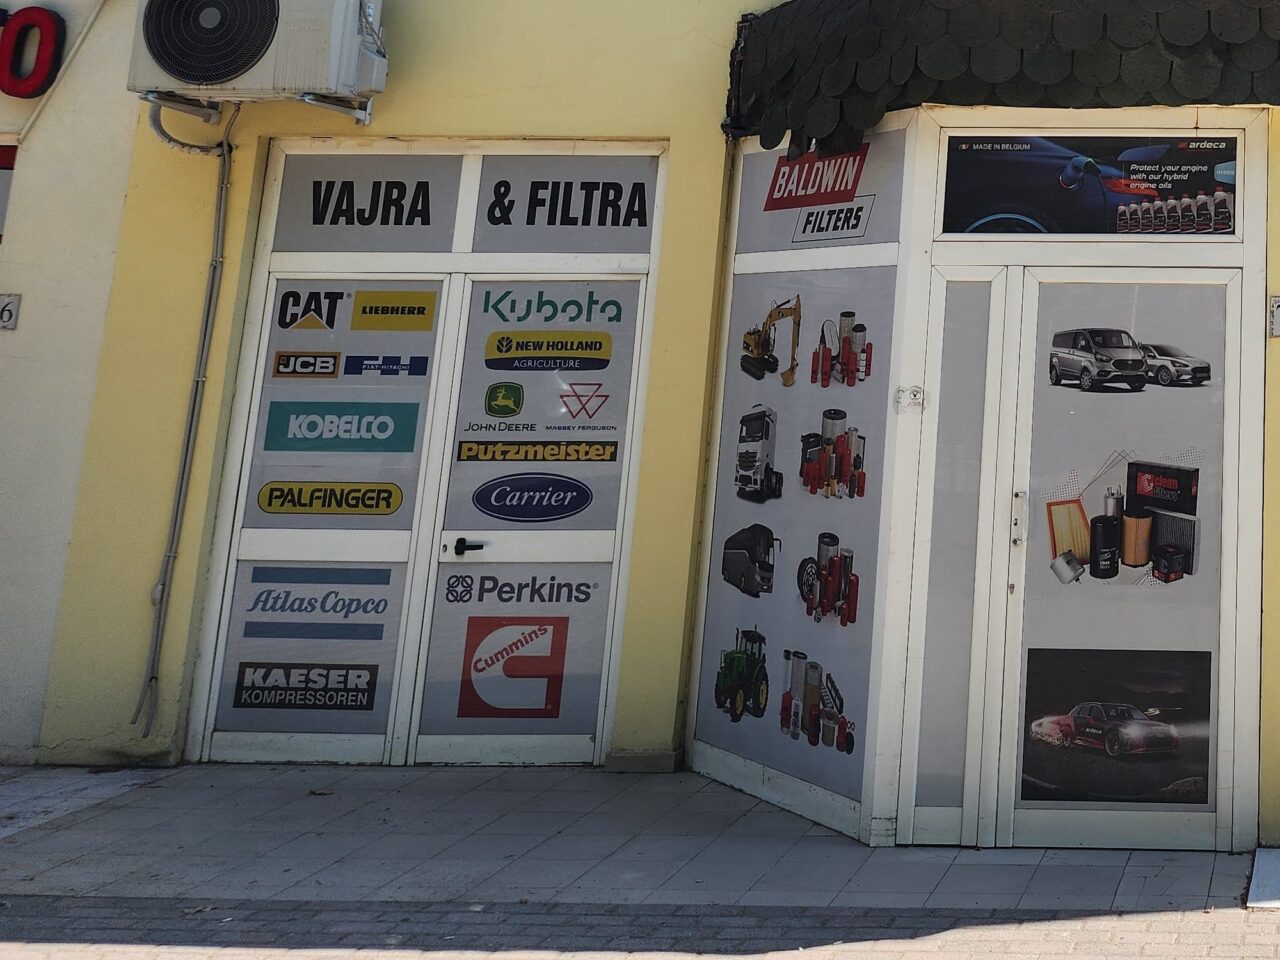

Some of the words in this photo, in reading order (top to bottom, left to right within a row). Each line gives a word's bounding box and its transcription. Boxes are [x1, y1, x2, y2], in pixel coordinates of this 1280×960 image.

[773, 156, 860, 198] BALDWIN
[1130, 164, 1159, 172] Protect
[1161, 165, 1180, 173] your
[1181, 164, 1208, 173] engine
[1163, 172, 1188, 181] hybrid
[1129, 182, 1157, 190] engine
[312, 180, 431, 226] VAJRA
[487, 180, 516, 226] &
[526, 181, 648, 227] FILTRA
[802, 206, 864, 234] FILTERS
[278, 291, 344, 329] CAT
[361, 306, 426, 315] LIEBHERR
[484, 291, 622, 323] Kubota
[516, 341, 544, 351] NEW
[547, 341, 602, 351] HOLLAND
[279, 357, 335, 373] JCB
[513, 360, 580, 368] AGRICULTURE
[287, 414, 394, 440] KOBELCO
[464, 422, 496, 431] JOHN
[498, 422, 536, 431] DEERE
[460, 442, 614, 460] Putzmeister
[268, 488, 392, 509] PALFINGER
[490, 486, 577, 506] Carrier
[478, 575, 592, 602] Perkins
[246, 589, 318, 613] Atlas
[320, 591, 387, 618] Copco
[473, 624, 548, 674] Cummins
[243, 668, 370, 689] KAESER
[241, 690, 368, 705] KOMPRESSOREN
